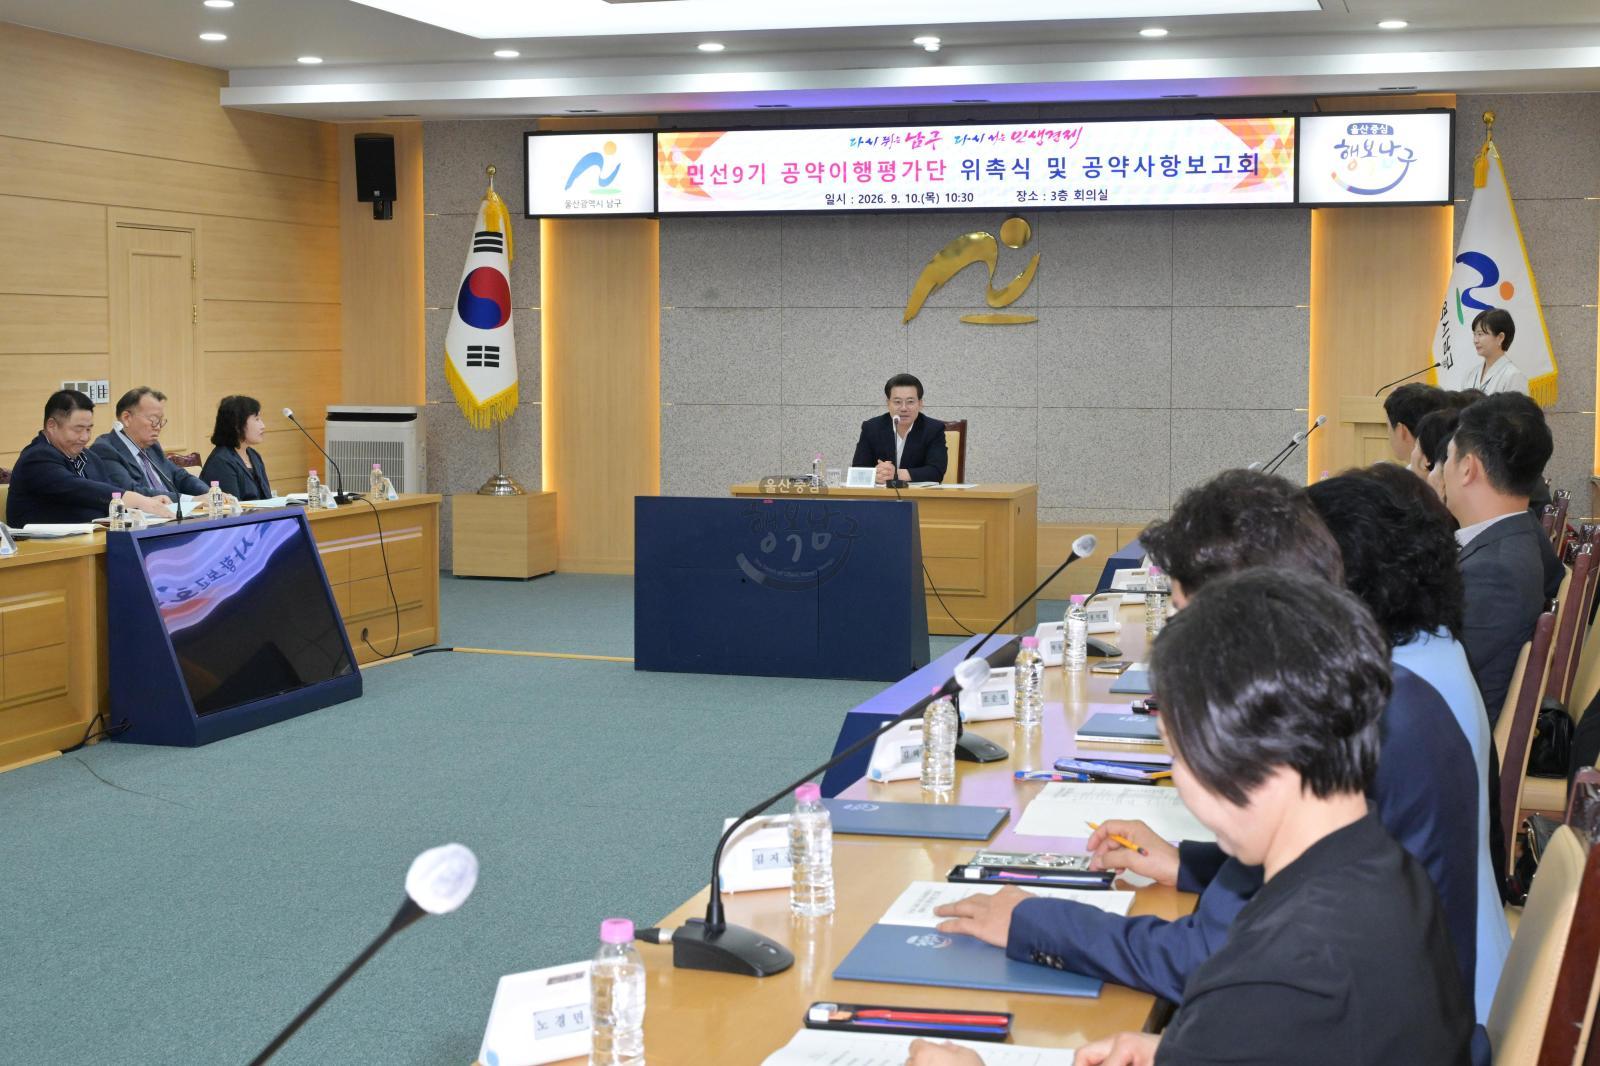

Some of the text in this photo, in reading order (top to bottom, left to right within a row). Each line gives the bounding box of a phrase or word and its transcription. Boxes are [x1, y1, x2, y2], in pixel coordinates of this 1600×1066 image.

[1350, 124, 1388, 135] 울산중심
[904, 130, 943, 150] 남구
[687, 152, 1259, 186] 민선9기 공약이행평가단 위촉식 및 공약사항보고회
[825, 192, 846, 206] 일시
[858, 193, 886, 204] 2026.
[890, 193, 900, 204] 9.
[905, 191, 940, 205] 10.(목)
[945, 192, 974, 203] 10:30
[1016, 189, 1039, 202] 장소
[1050, 189, 1068, 201] 3층
[1073, 188, 1108, 202] 회의실
[564, 198, 623, 209] 울산광역시 남구
